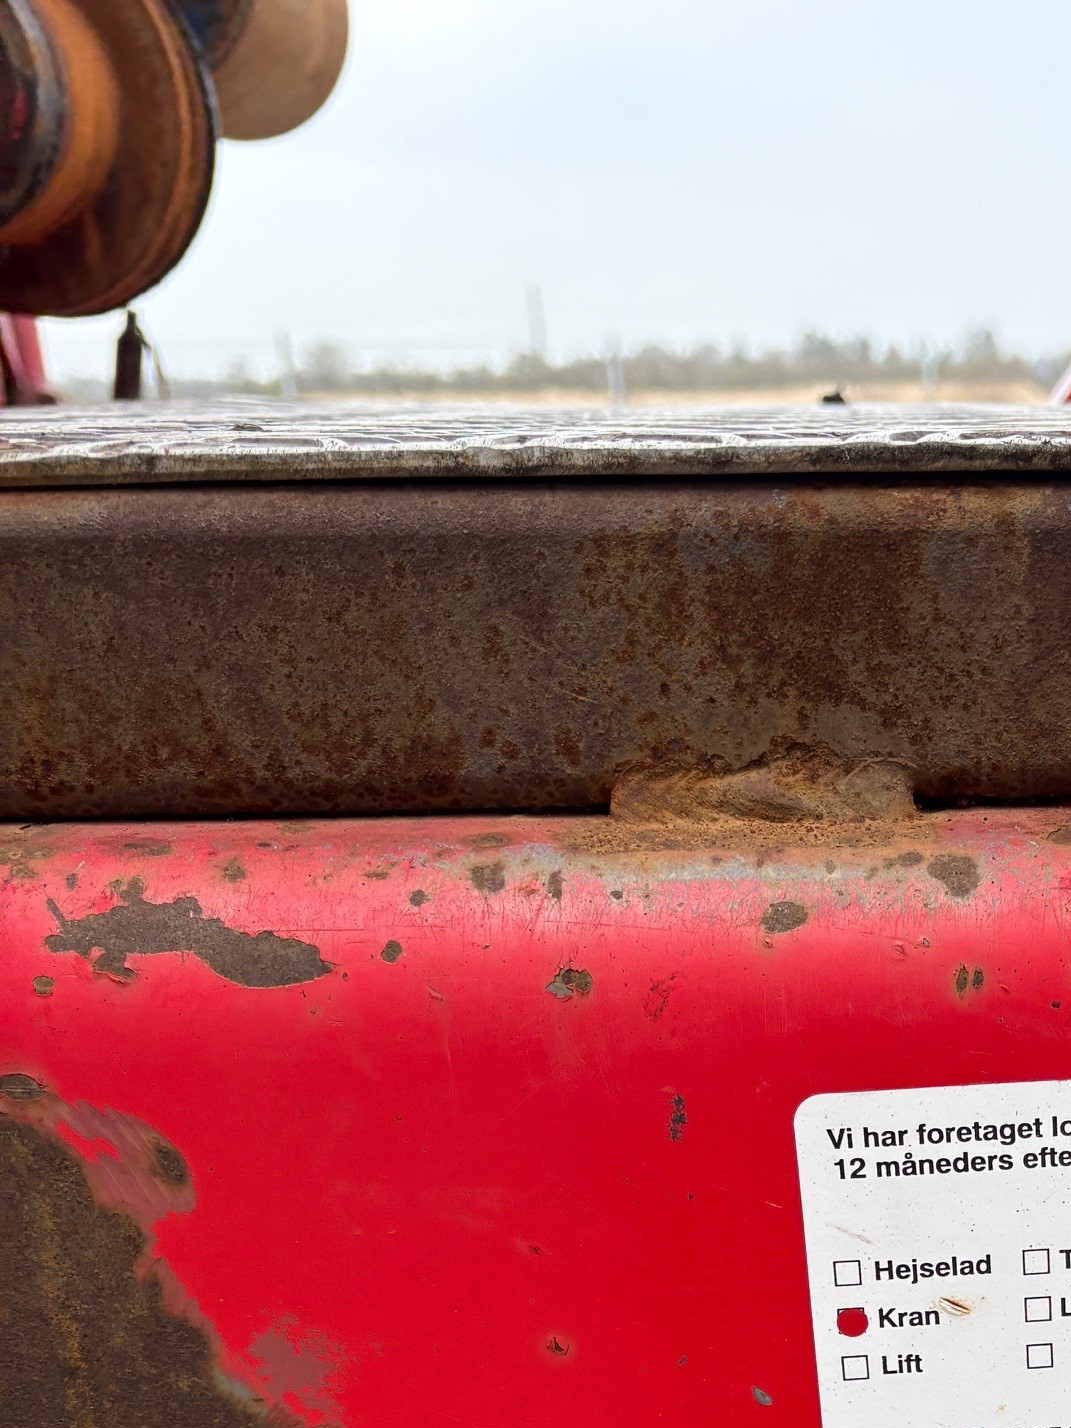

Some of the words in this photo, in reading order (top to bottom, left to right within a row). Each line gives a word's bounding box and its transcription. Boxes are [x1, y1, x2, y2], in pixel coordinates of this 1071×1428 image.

[826, 1128, 854, 1150] Vi
[863, 1124, 909, 1149] har
[916, 1117, 1044, 1148] foretaget
[834, 1157, 867, 1180] 12
[876, 1150, 1014, 1178] måneders
[874, 1254, 992, 1285] Hejselad
[878, 1307, 940, 1329] Kran
[882, 1354, 923, 1375] Lift
